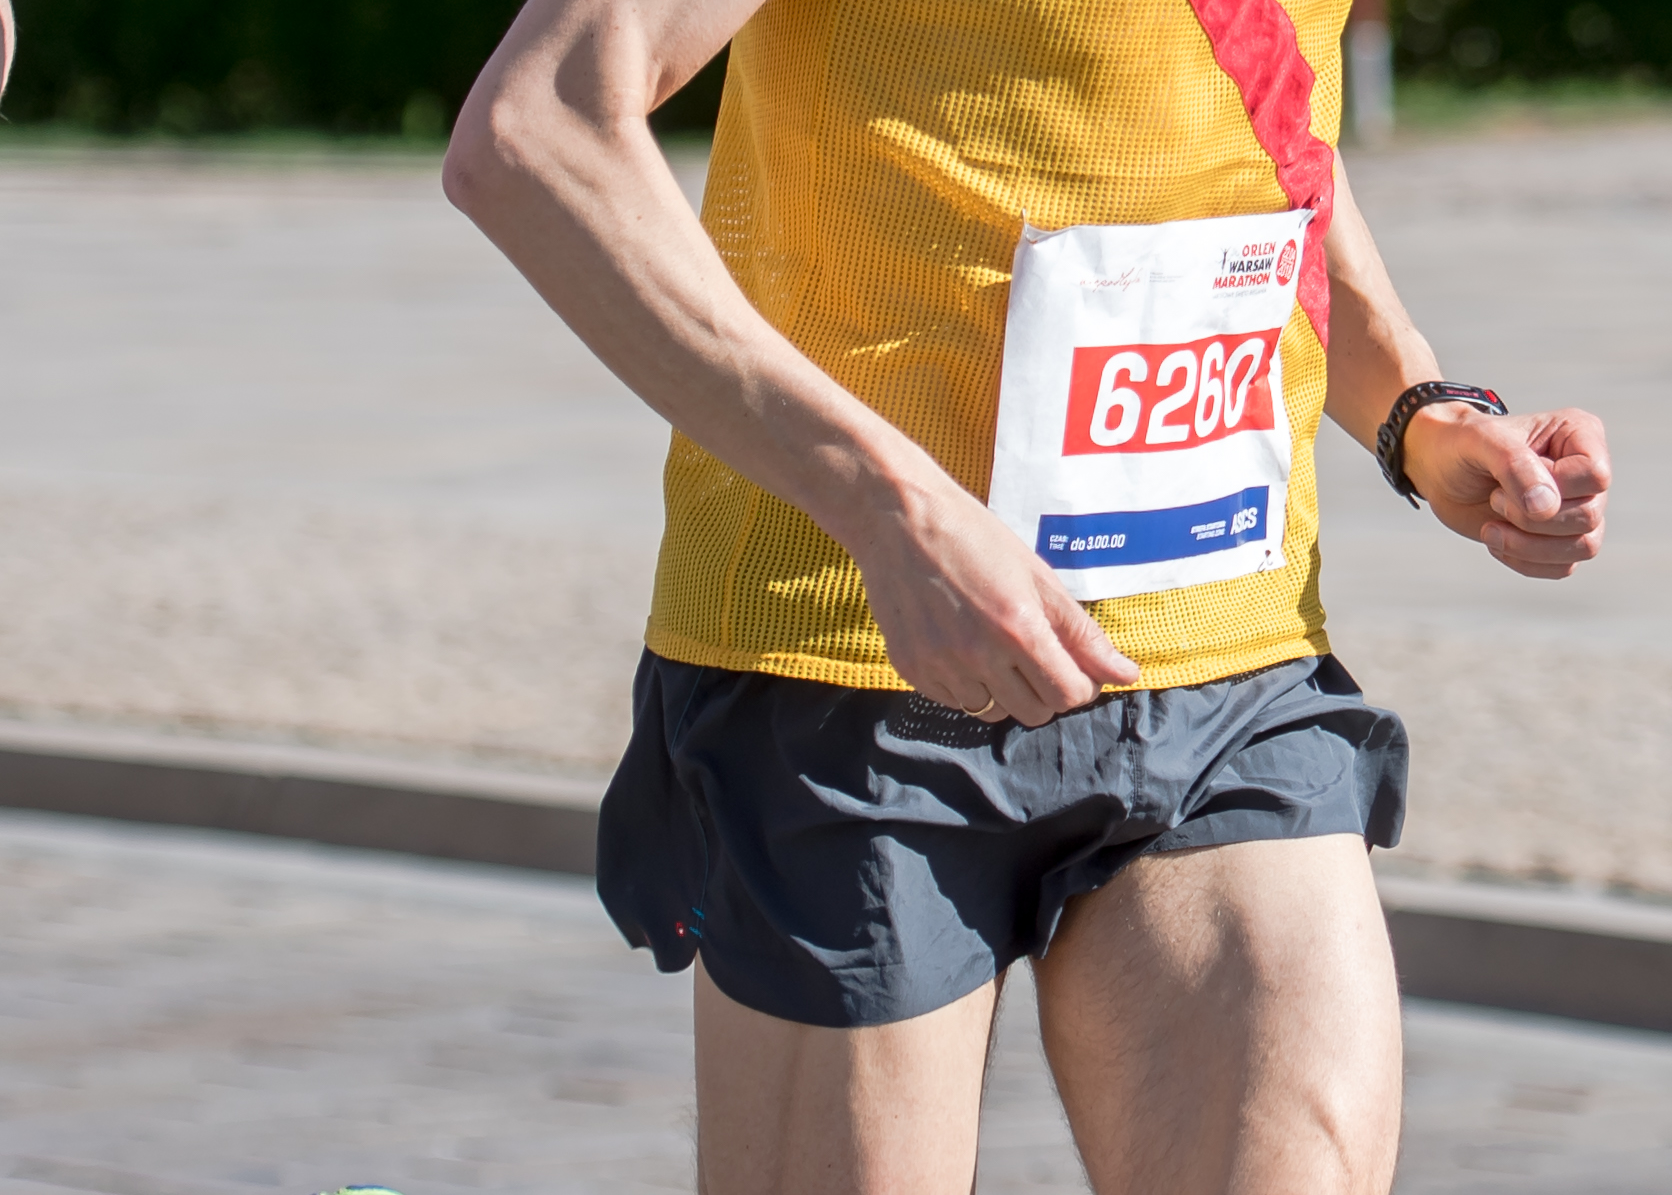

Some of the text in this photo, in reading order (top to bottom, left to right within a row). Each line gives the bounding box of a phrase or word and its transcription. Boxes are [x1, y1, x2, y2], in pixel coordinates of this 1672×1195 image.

[1241, 241, 1276, 257] ORLEN
[1229, 257, 1274, 274] WARSAW
[1212, 272, 1271, 290] MARATHON
[1089, 337, 1266, 447] 6260
[1070, 536, 1086, 551] do
